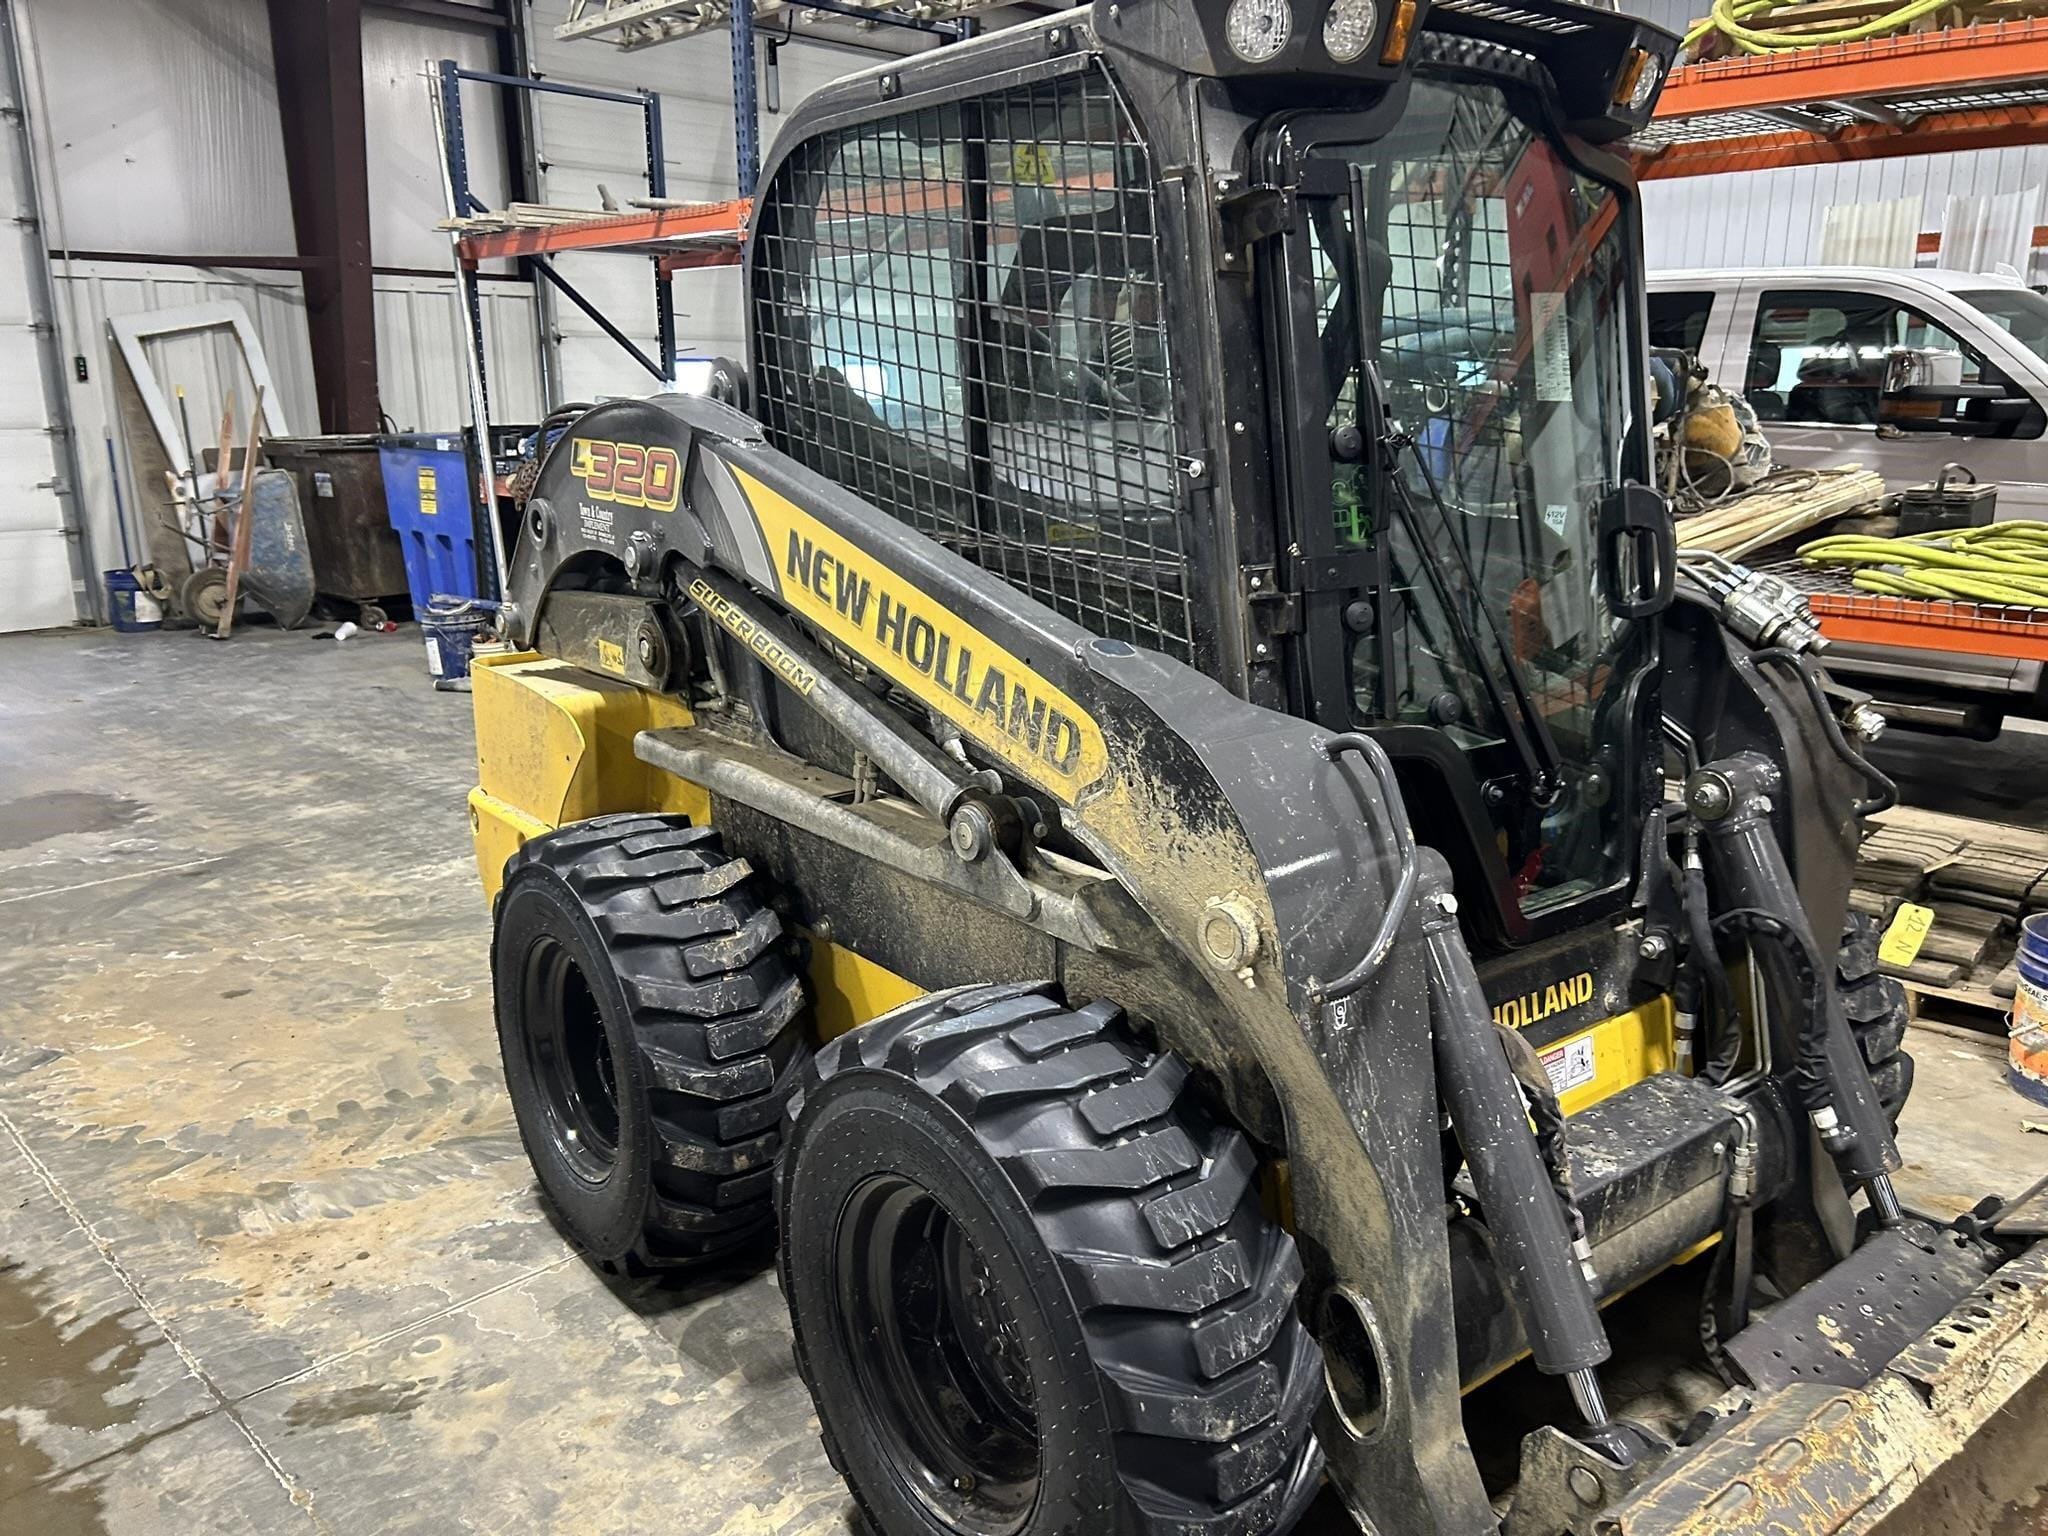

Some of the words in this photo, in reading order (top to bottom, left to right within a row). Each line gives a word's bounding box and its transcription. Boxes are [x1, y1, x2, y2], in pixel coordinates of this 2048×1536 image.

[785, 528, 871, 631] NEW
[875, 590, 1082, 778] HOLLAND
[1543, 1048, 1565, 1064] DANGER
